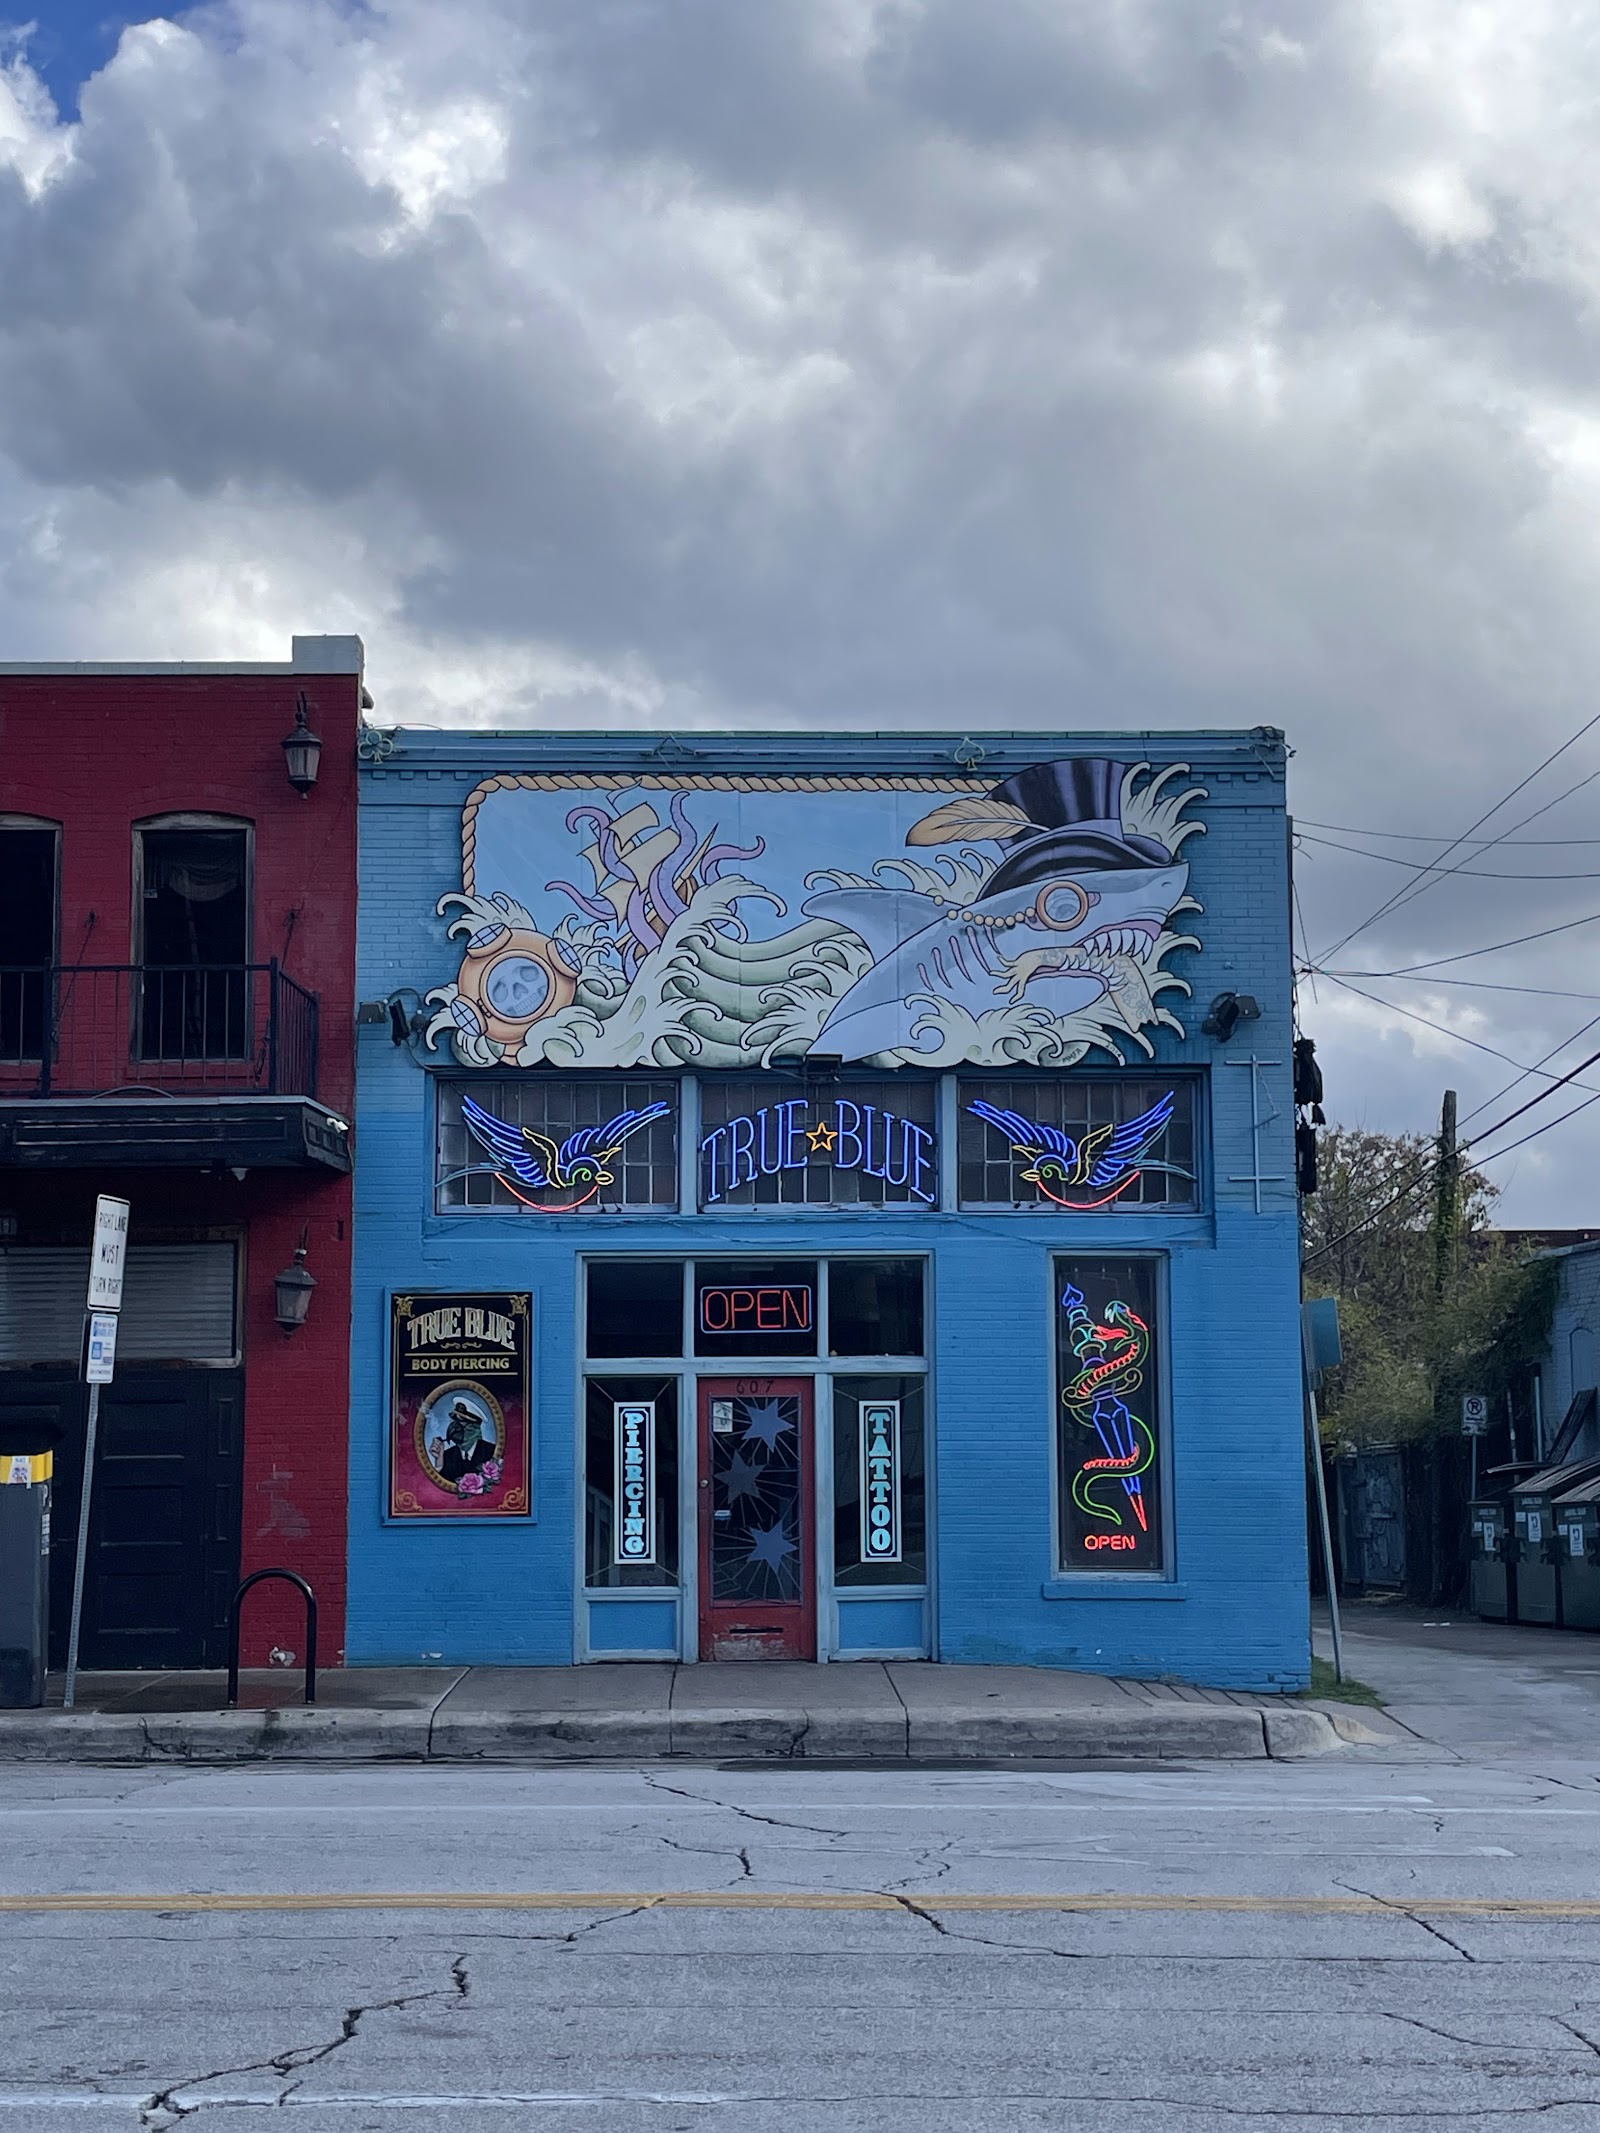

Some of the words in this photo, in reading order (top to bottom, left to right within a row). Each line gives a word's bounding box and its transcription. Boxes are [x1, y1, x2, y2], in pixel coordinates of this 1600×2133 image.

[702, 1099, 808, 1201] TRUE
[835, 1099, 934, 1203] BLUE
[101, 1243, 119, 1264] MUST
[407, 1307, 461, 1350] TRUE
[465, 1307, 515, 1350] BLUE
[705, 1289, 807, 1329] OPEN
[411, 1359, 449, 1371] BODY
[450, 1357, 510, 1370] PIERCING
[736, 1380, 774, 1394] 607
[624, 1412, 646, 1554] PIERCING
[868, 1412, 892, 1551] TATTOO
[1084, 1534, 1136, 1550] OPEN
